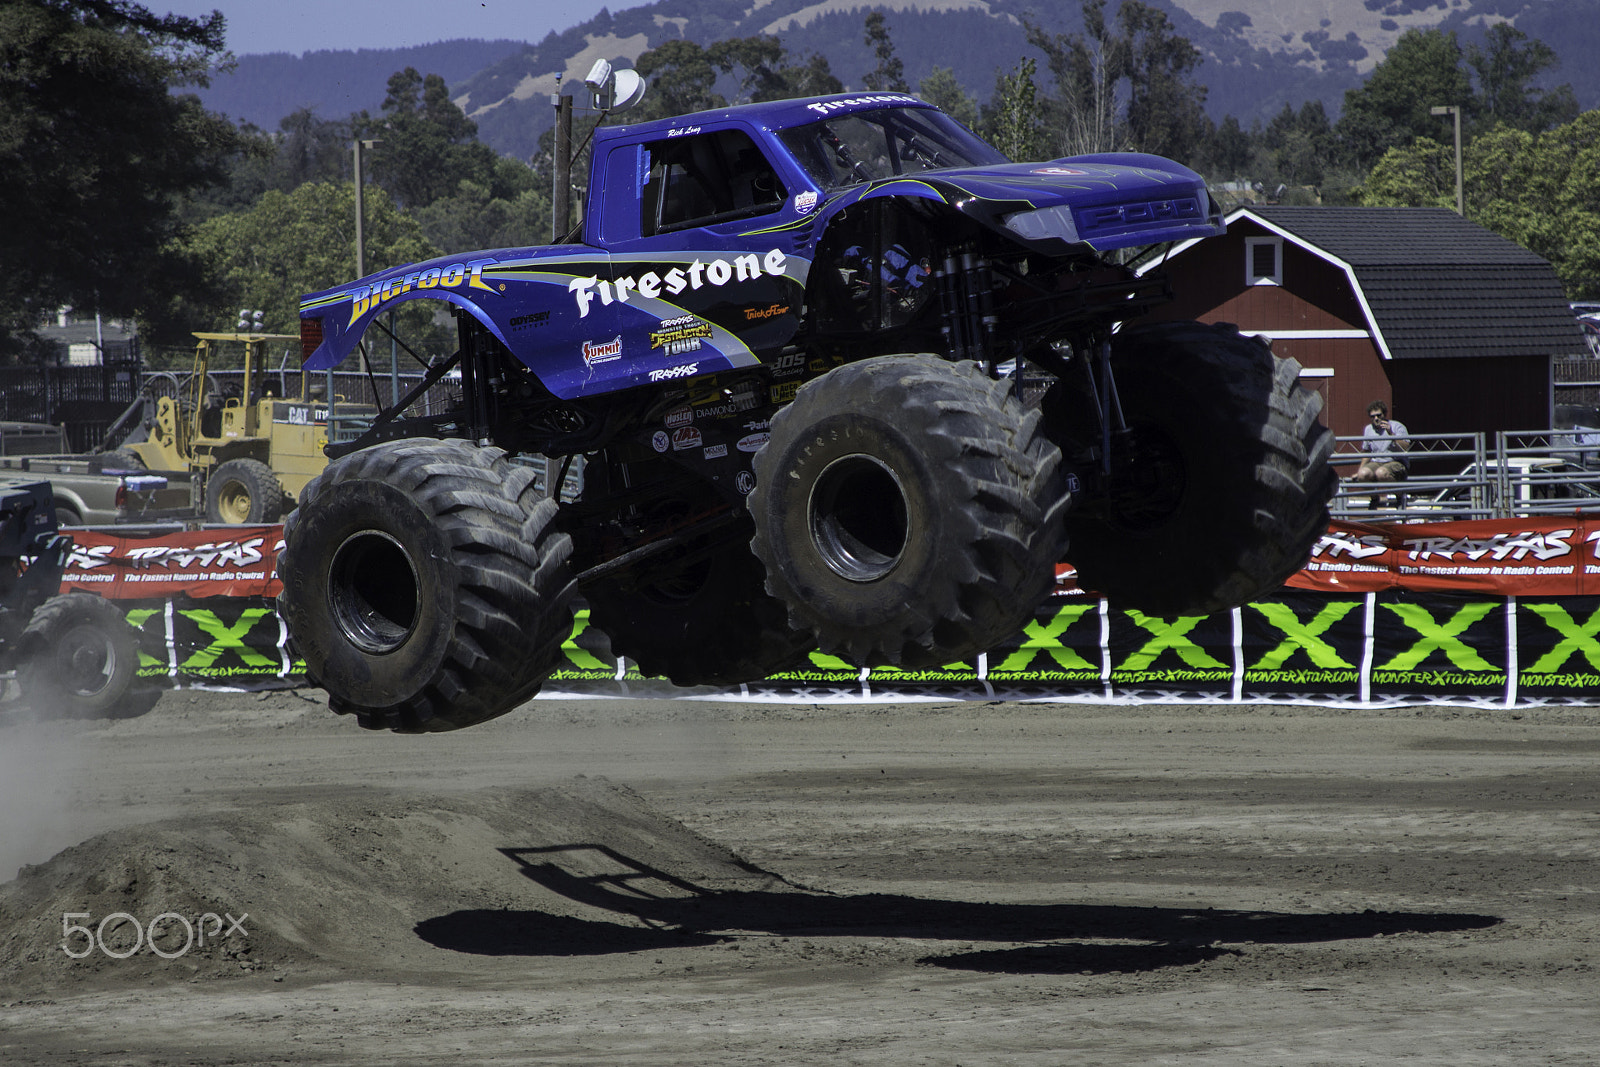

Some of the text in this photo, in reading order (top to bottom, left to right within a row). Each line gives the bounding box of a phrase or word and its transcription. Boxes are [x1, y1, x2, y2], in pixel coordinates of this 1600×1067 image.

[807, 95, 917, 114] Firestone
[568, 248, 787, 318] Firestone
[345, 258, 504, 334] BIGFOOT
[510, 311, 551, 326] ODYSSEY
[661, 314, 694, 328] TRAXXAS
[648, 323, 713, 350] DESTRUCTION
[664, 336, 701, 357] TOUR
[648, 363, 699, 381] TRAXXAS
[289, 406, 308, 425] CAT
[696, 404, 737, 419] DIAMOND
[738, 473, 753, 491] KC
[125, 538, 264, 569] TRAXXAS
[1402, 528, 1576, 562] TRAXXAS
[124, 573, 140, 582] The
[141, 573, 172, 582] Fastest
[199, 573, 209, 581] In
[209, 572, 234, 580] Radio
[235, 571, 265, 581] Control
[1308, 562, 1389, 573] In Radio Control
[1399, 564, 1574, 575] The Fastest Name In Radio Control
[80, 573, 116, 582] Control
[1245, 669, 1359, 684] MONSTERXTOUR.COM
[1372, 670, 1508, 686] MONSTERXTOUR.COM
